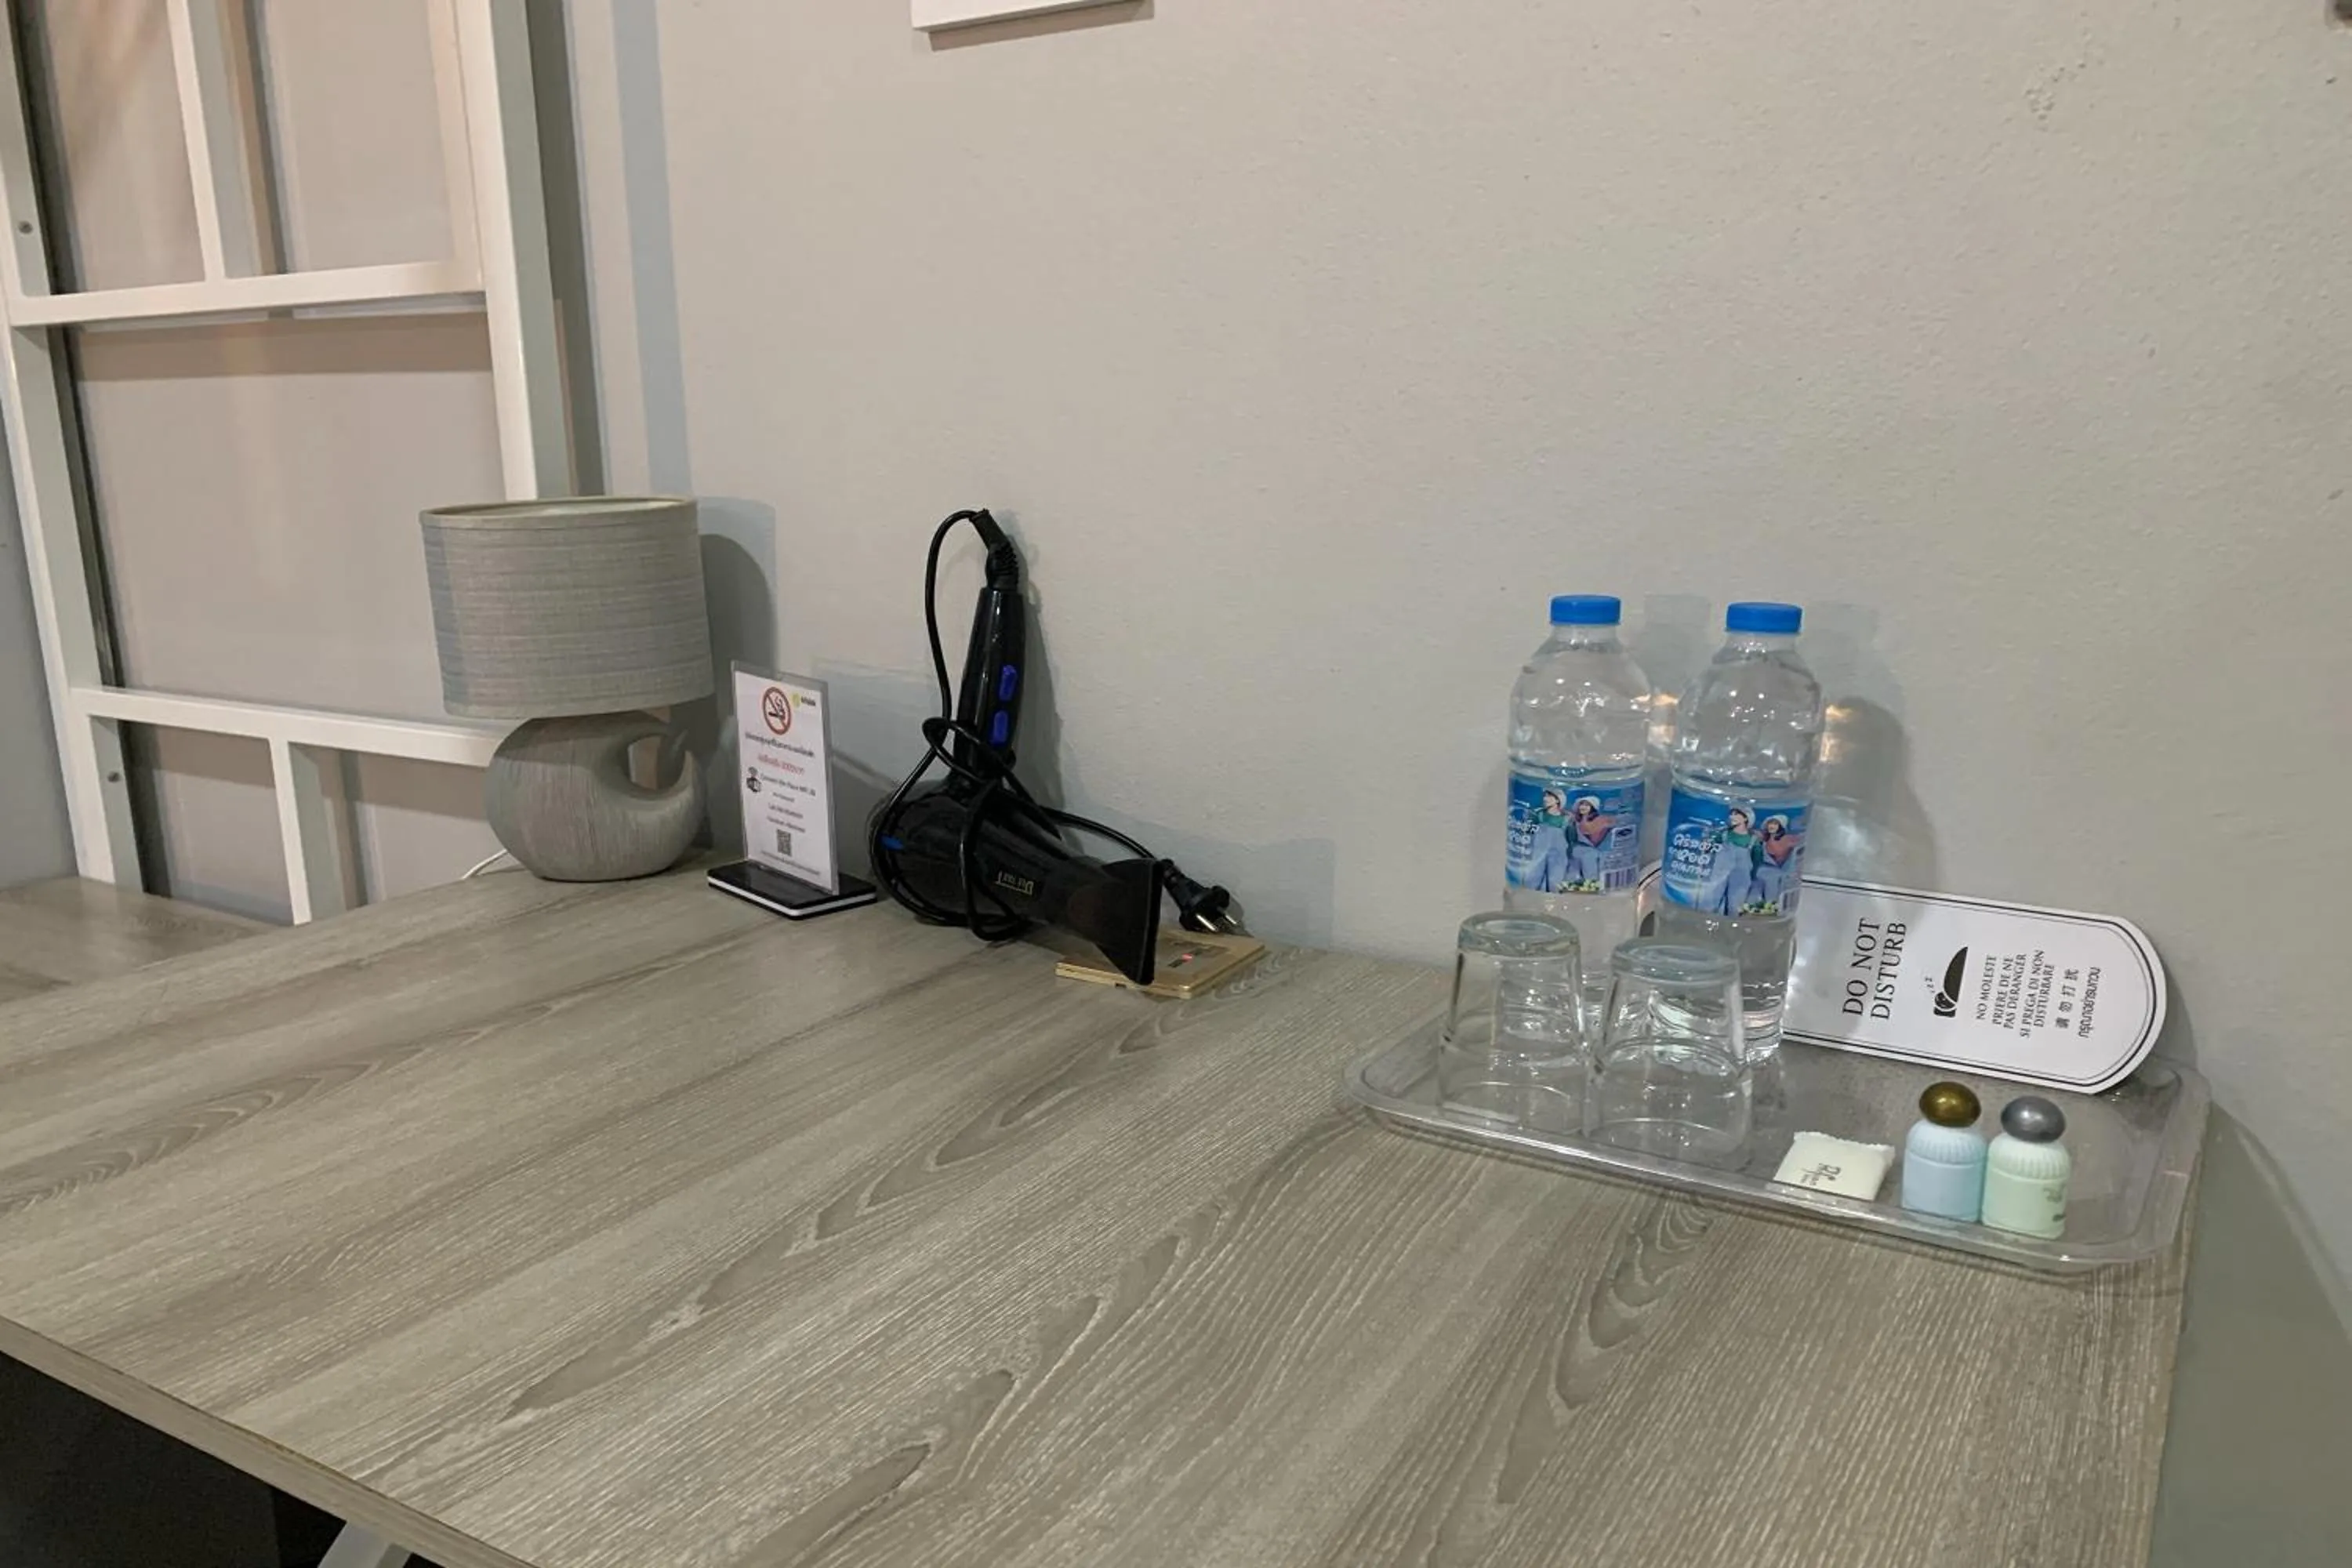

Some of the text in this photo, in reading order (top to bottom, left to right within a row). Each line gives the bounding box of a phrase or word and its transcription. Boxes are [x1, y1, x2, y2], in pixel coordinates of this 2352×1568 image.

[1842, 917, 1880, 1016] DO NOT
[1871, 922, 1907, 1020] DISTURB
[1976, 955, 1997, 1019] NO MOLESTE
[1992, 957, 2014, 1025] PRIERE DE NE
[2003, 954, 2027, 1029] PAS DERANGER
[2020, 949, 2045, 1038] SI PREGA DI NON
[2033, 964, 2055, 1027] DISTURBARE
